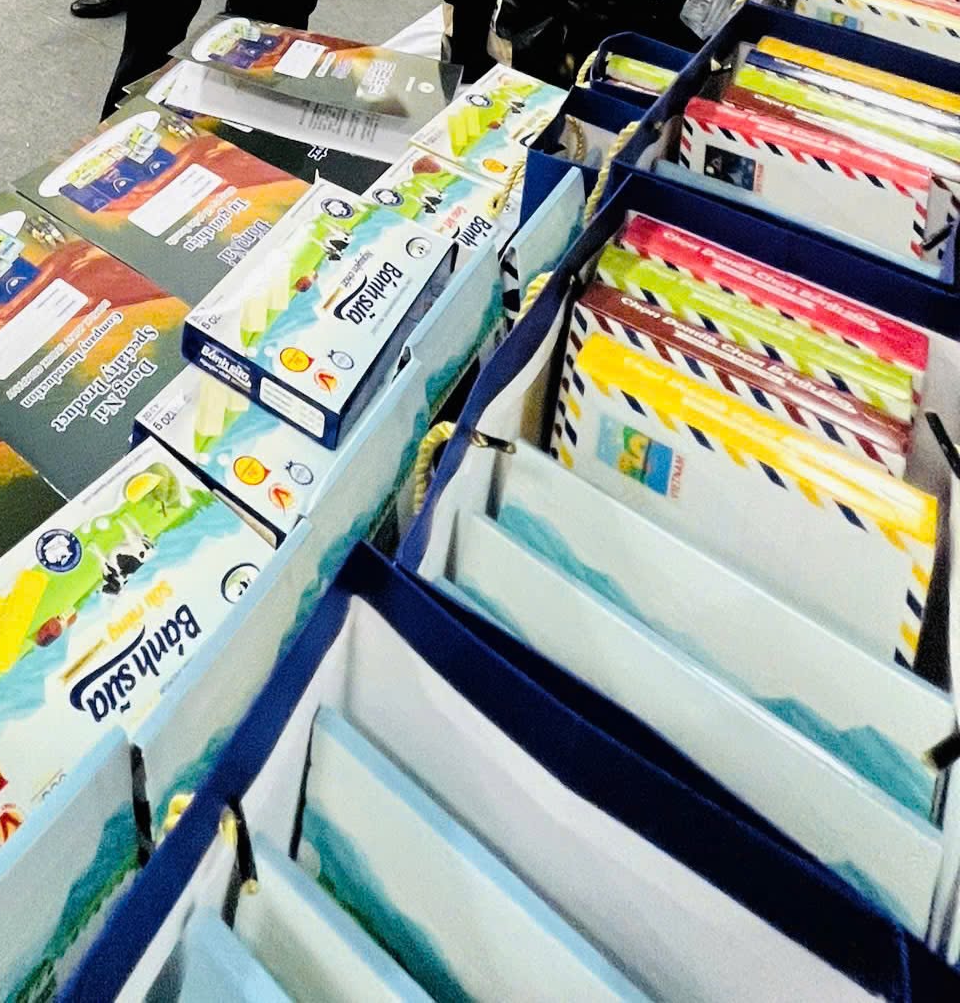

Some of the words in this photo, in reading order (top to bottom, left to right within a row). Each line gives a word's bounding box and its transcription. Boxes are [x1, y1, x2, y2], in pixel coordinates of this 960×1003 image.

[362, 261, 403, 302] Bánh
[80, 311, 121, 351] Company
[344, 293, 374, 325] sữa
[102, 326, 156, 379] Specialty
[22, 351, 83, 407] Introduction
[114, 358, 154, 396] Dong
[53, 378, 106, 430] Product
[92, 393, 122, 424] Nai
[130, 604, 202, 677] Bánh
[84, 662, 137, 722] sữa
